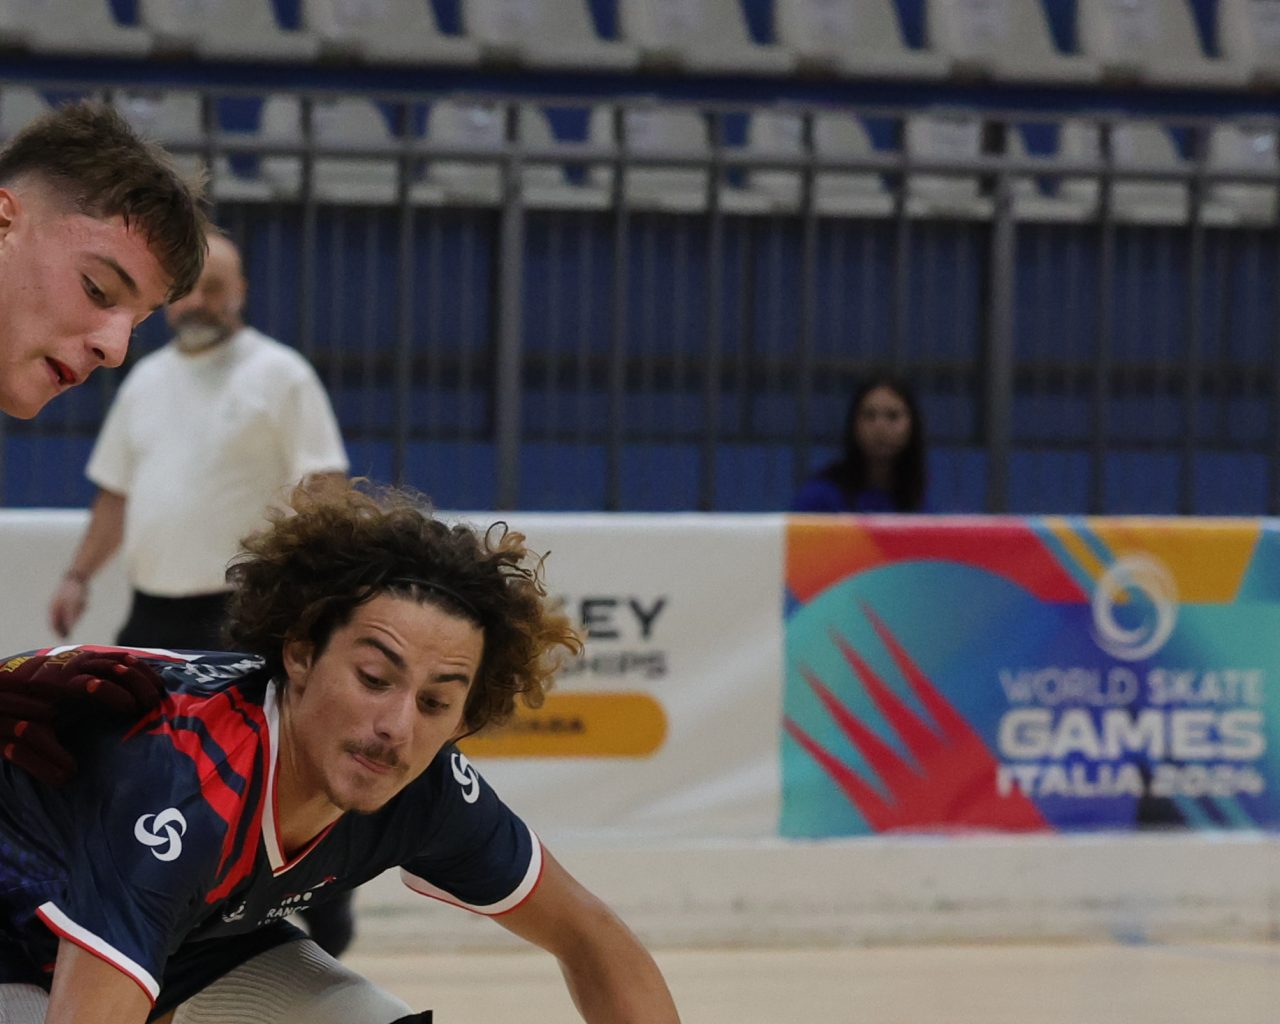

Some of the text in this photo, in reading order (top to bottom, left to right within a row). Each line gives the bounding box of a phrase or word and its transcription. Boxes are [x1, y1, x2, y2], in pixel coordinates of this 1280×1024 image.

[554, 596, 667, 640] EY
[998, 666, 1264, 706] WORLD SKATE
[996, 707, 1267, 761] GAMES
[995, 763, 1266, 798] ITALIA 2024
